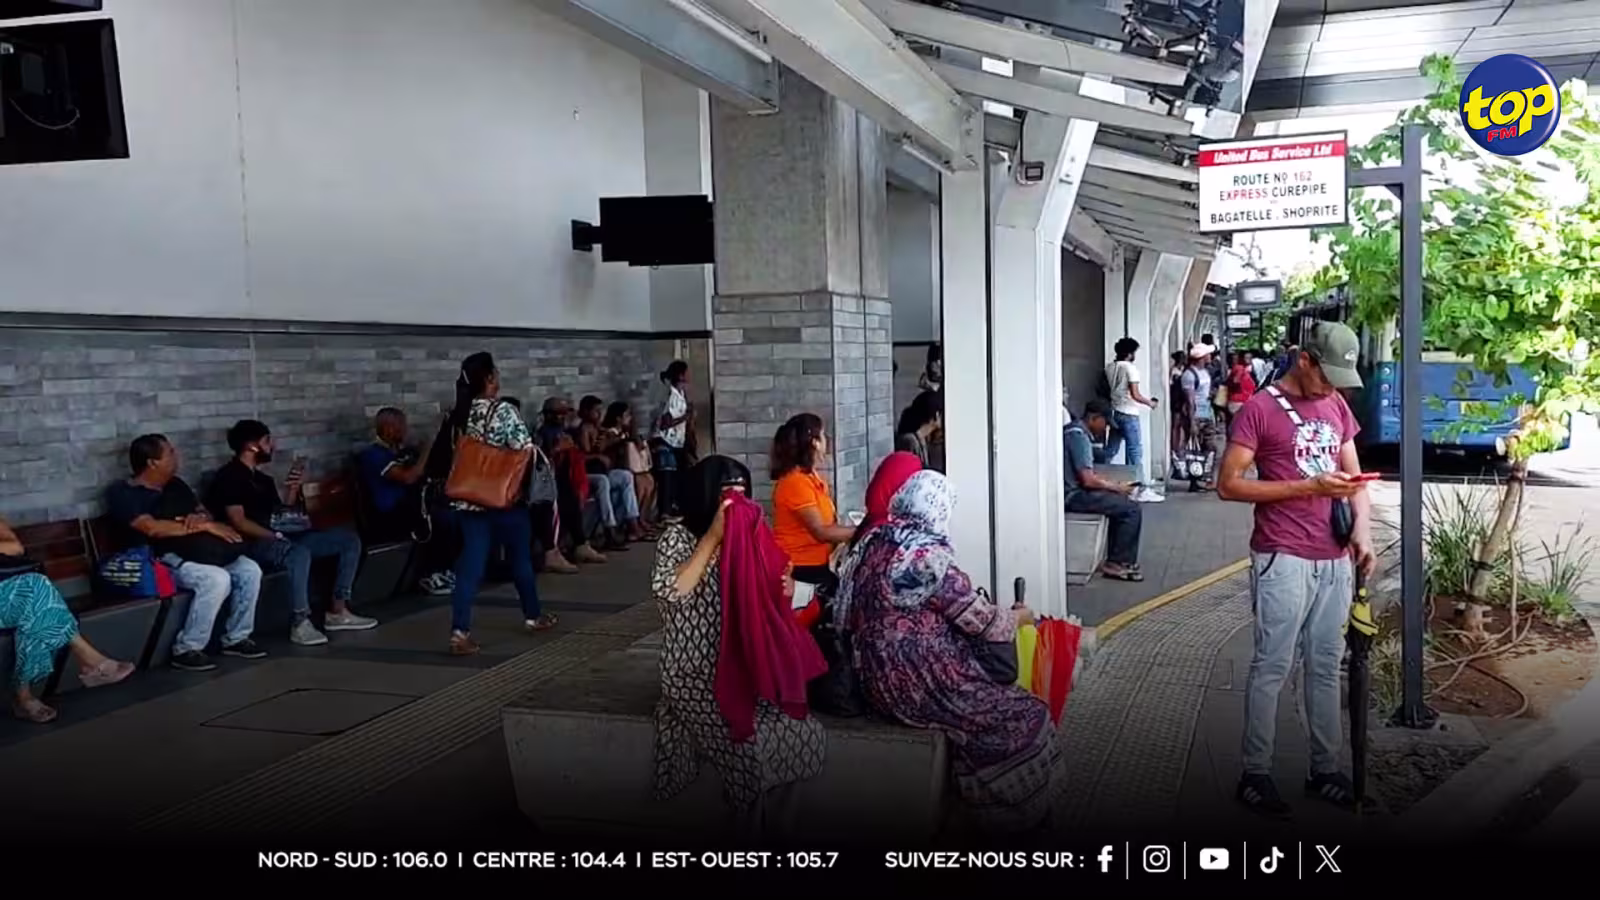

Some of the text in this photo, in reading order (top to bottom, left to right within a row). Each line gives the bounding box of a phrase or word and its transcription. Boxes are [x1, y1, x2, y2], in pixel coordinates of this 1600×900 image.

[1213, 143, 1333, 164] United Bus Service Ltd
[1233, 173, 1270, 186] ROUTE
[1293, 171, 1313, 182] 162
[1220, 183, 1327, 201] EXPRESS CUREPIPE
[1210, 204, 1339, 224] BAGATELLE SHOPRITE
